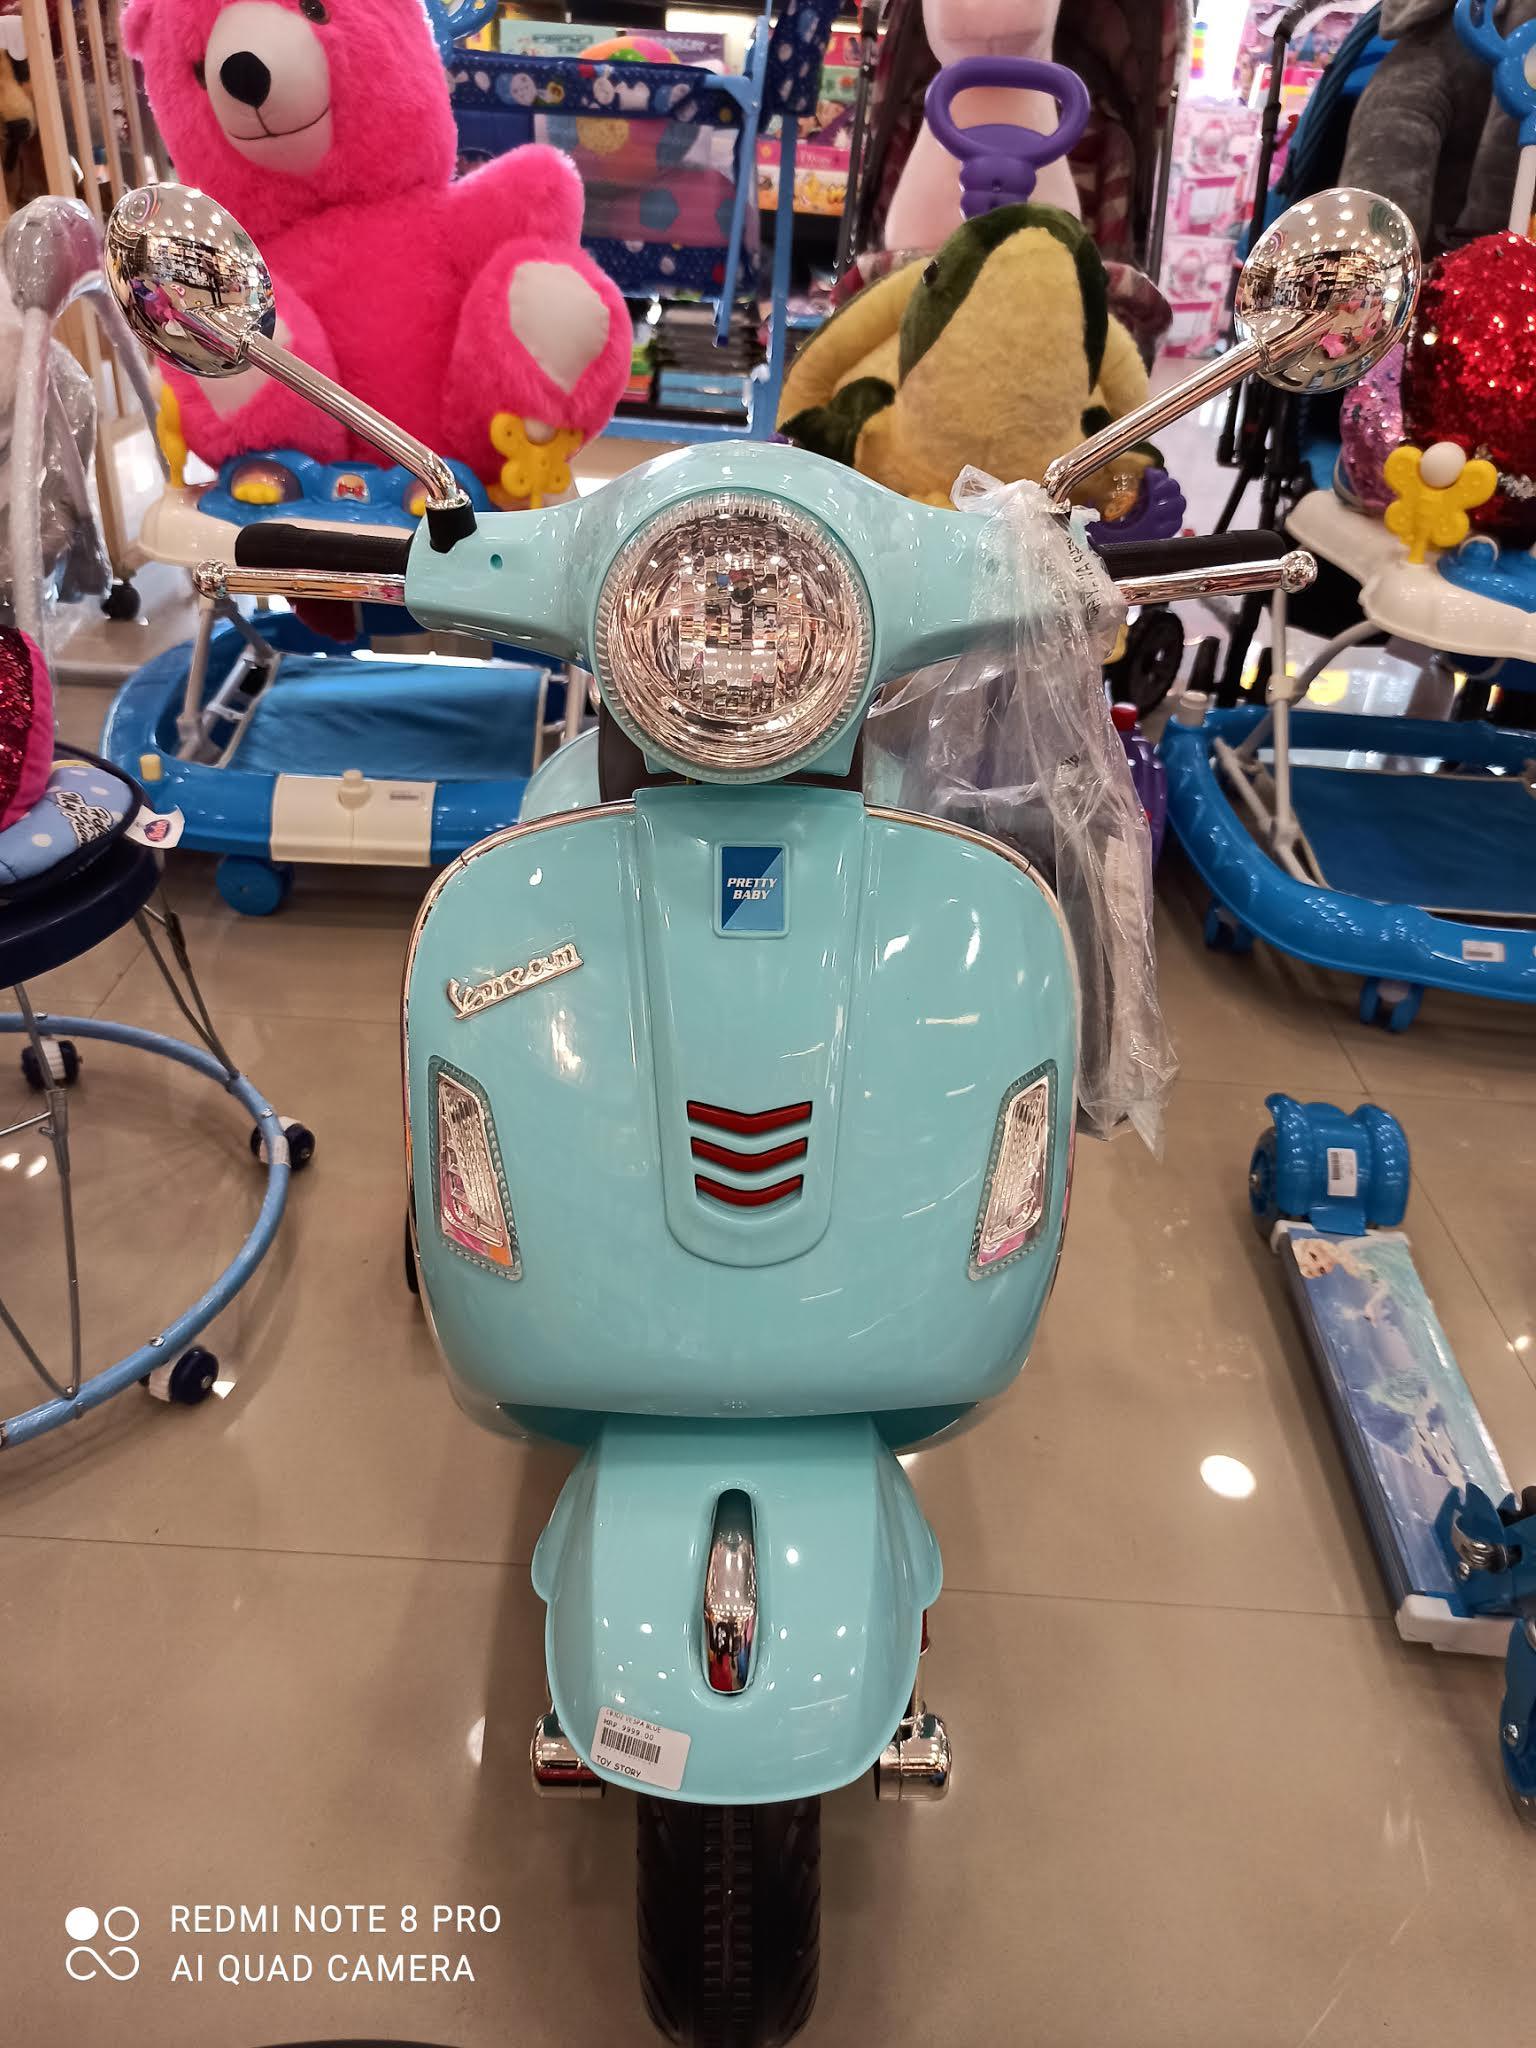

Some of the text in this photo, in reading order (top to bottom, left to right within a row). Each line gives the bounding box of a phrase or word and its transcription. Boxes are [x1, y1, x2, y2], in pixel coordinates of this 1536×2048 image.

[727, 878, 777, 888] PRETTY
[733, 890, 770, 900] BABY
[597, 1755, 641, 1778] TOY STORY
